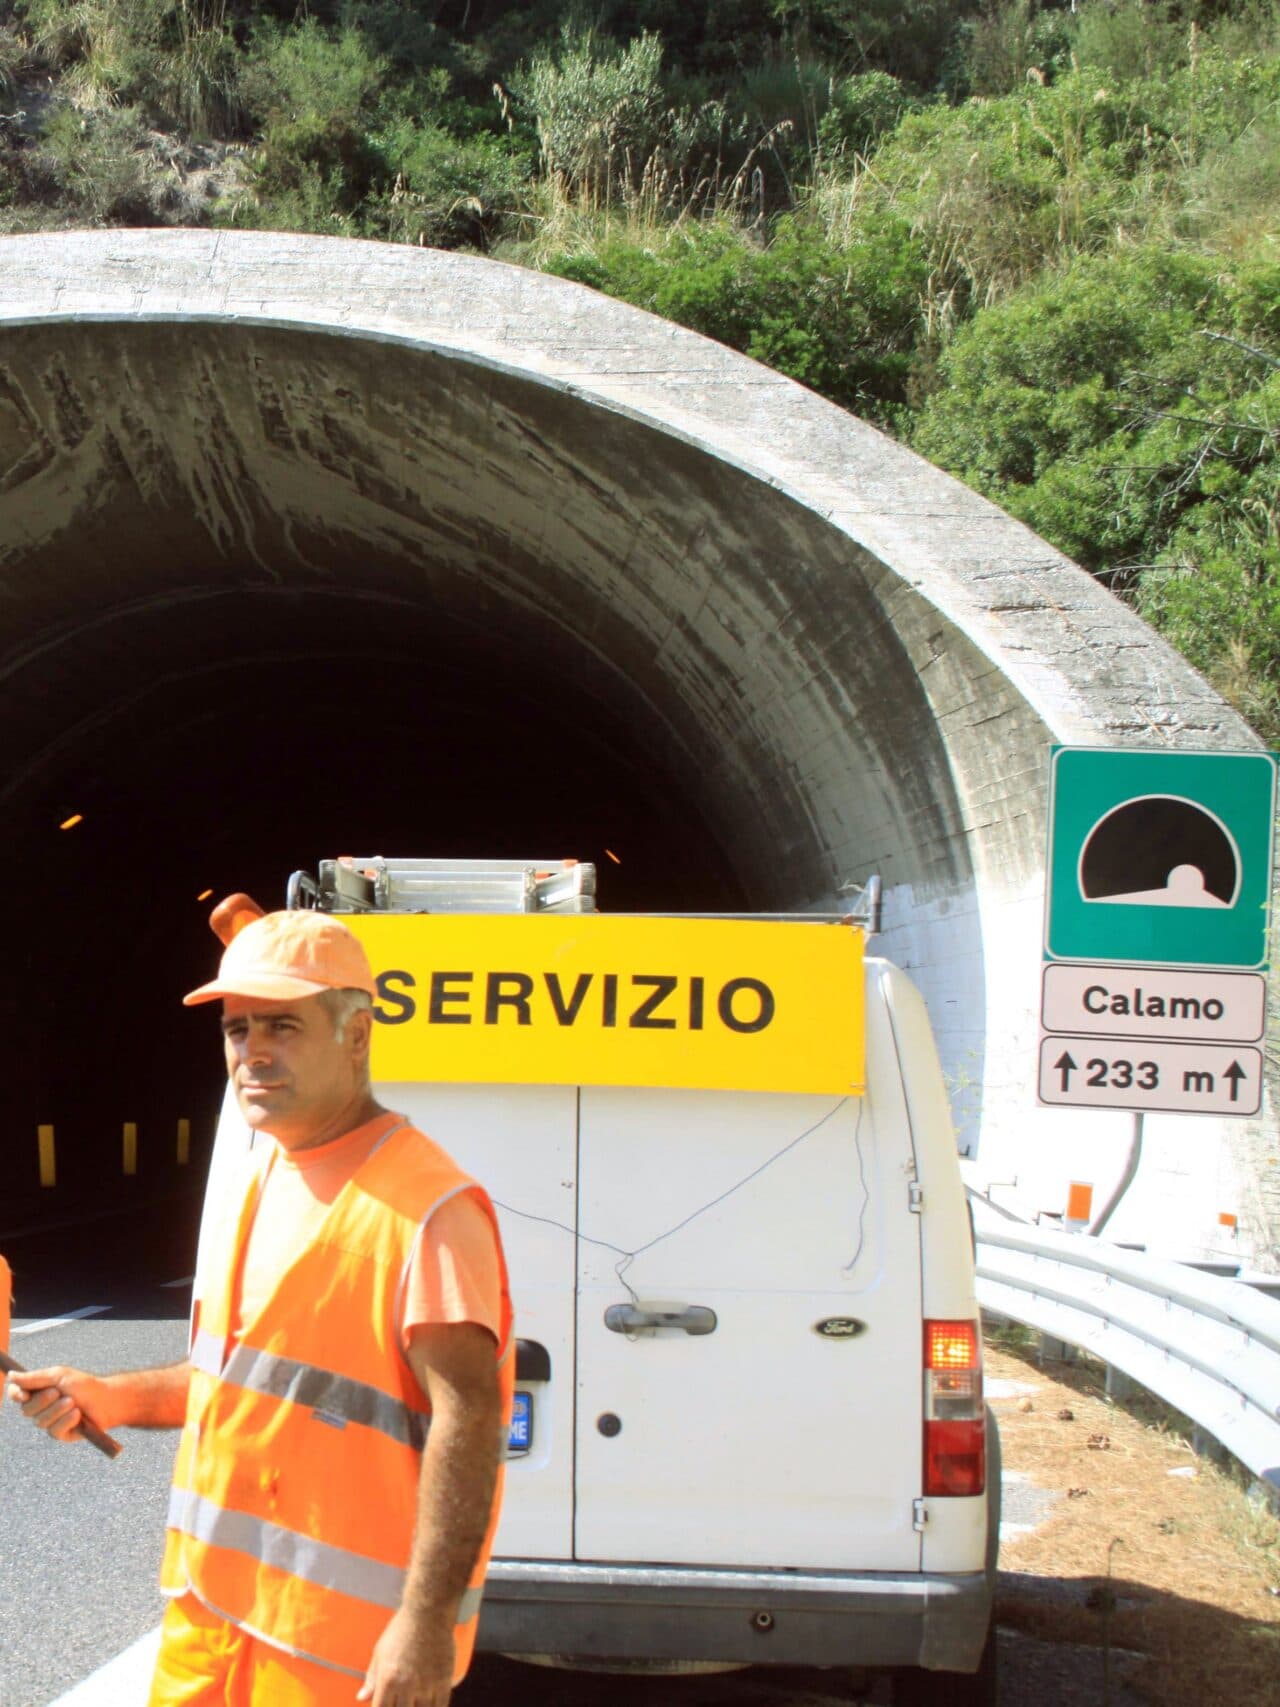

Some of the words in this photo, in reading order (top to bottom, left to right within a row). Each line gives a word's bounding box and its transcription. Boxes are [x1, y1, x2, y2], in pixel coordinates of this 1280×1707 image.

[373, 970, 776, 1034] SERVIZIO
[1082, 985, 1224, 1021] Calamo
[1086, 1058, 1160, 1091] 233
[1183, 1070, 1215, 1093] m
